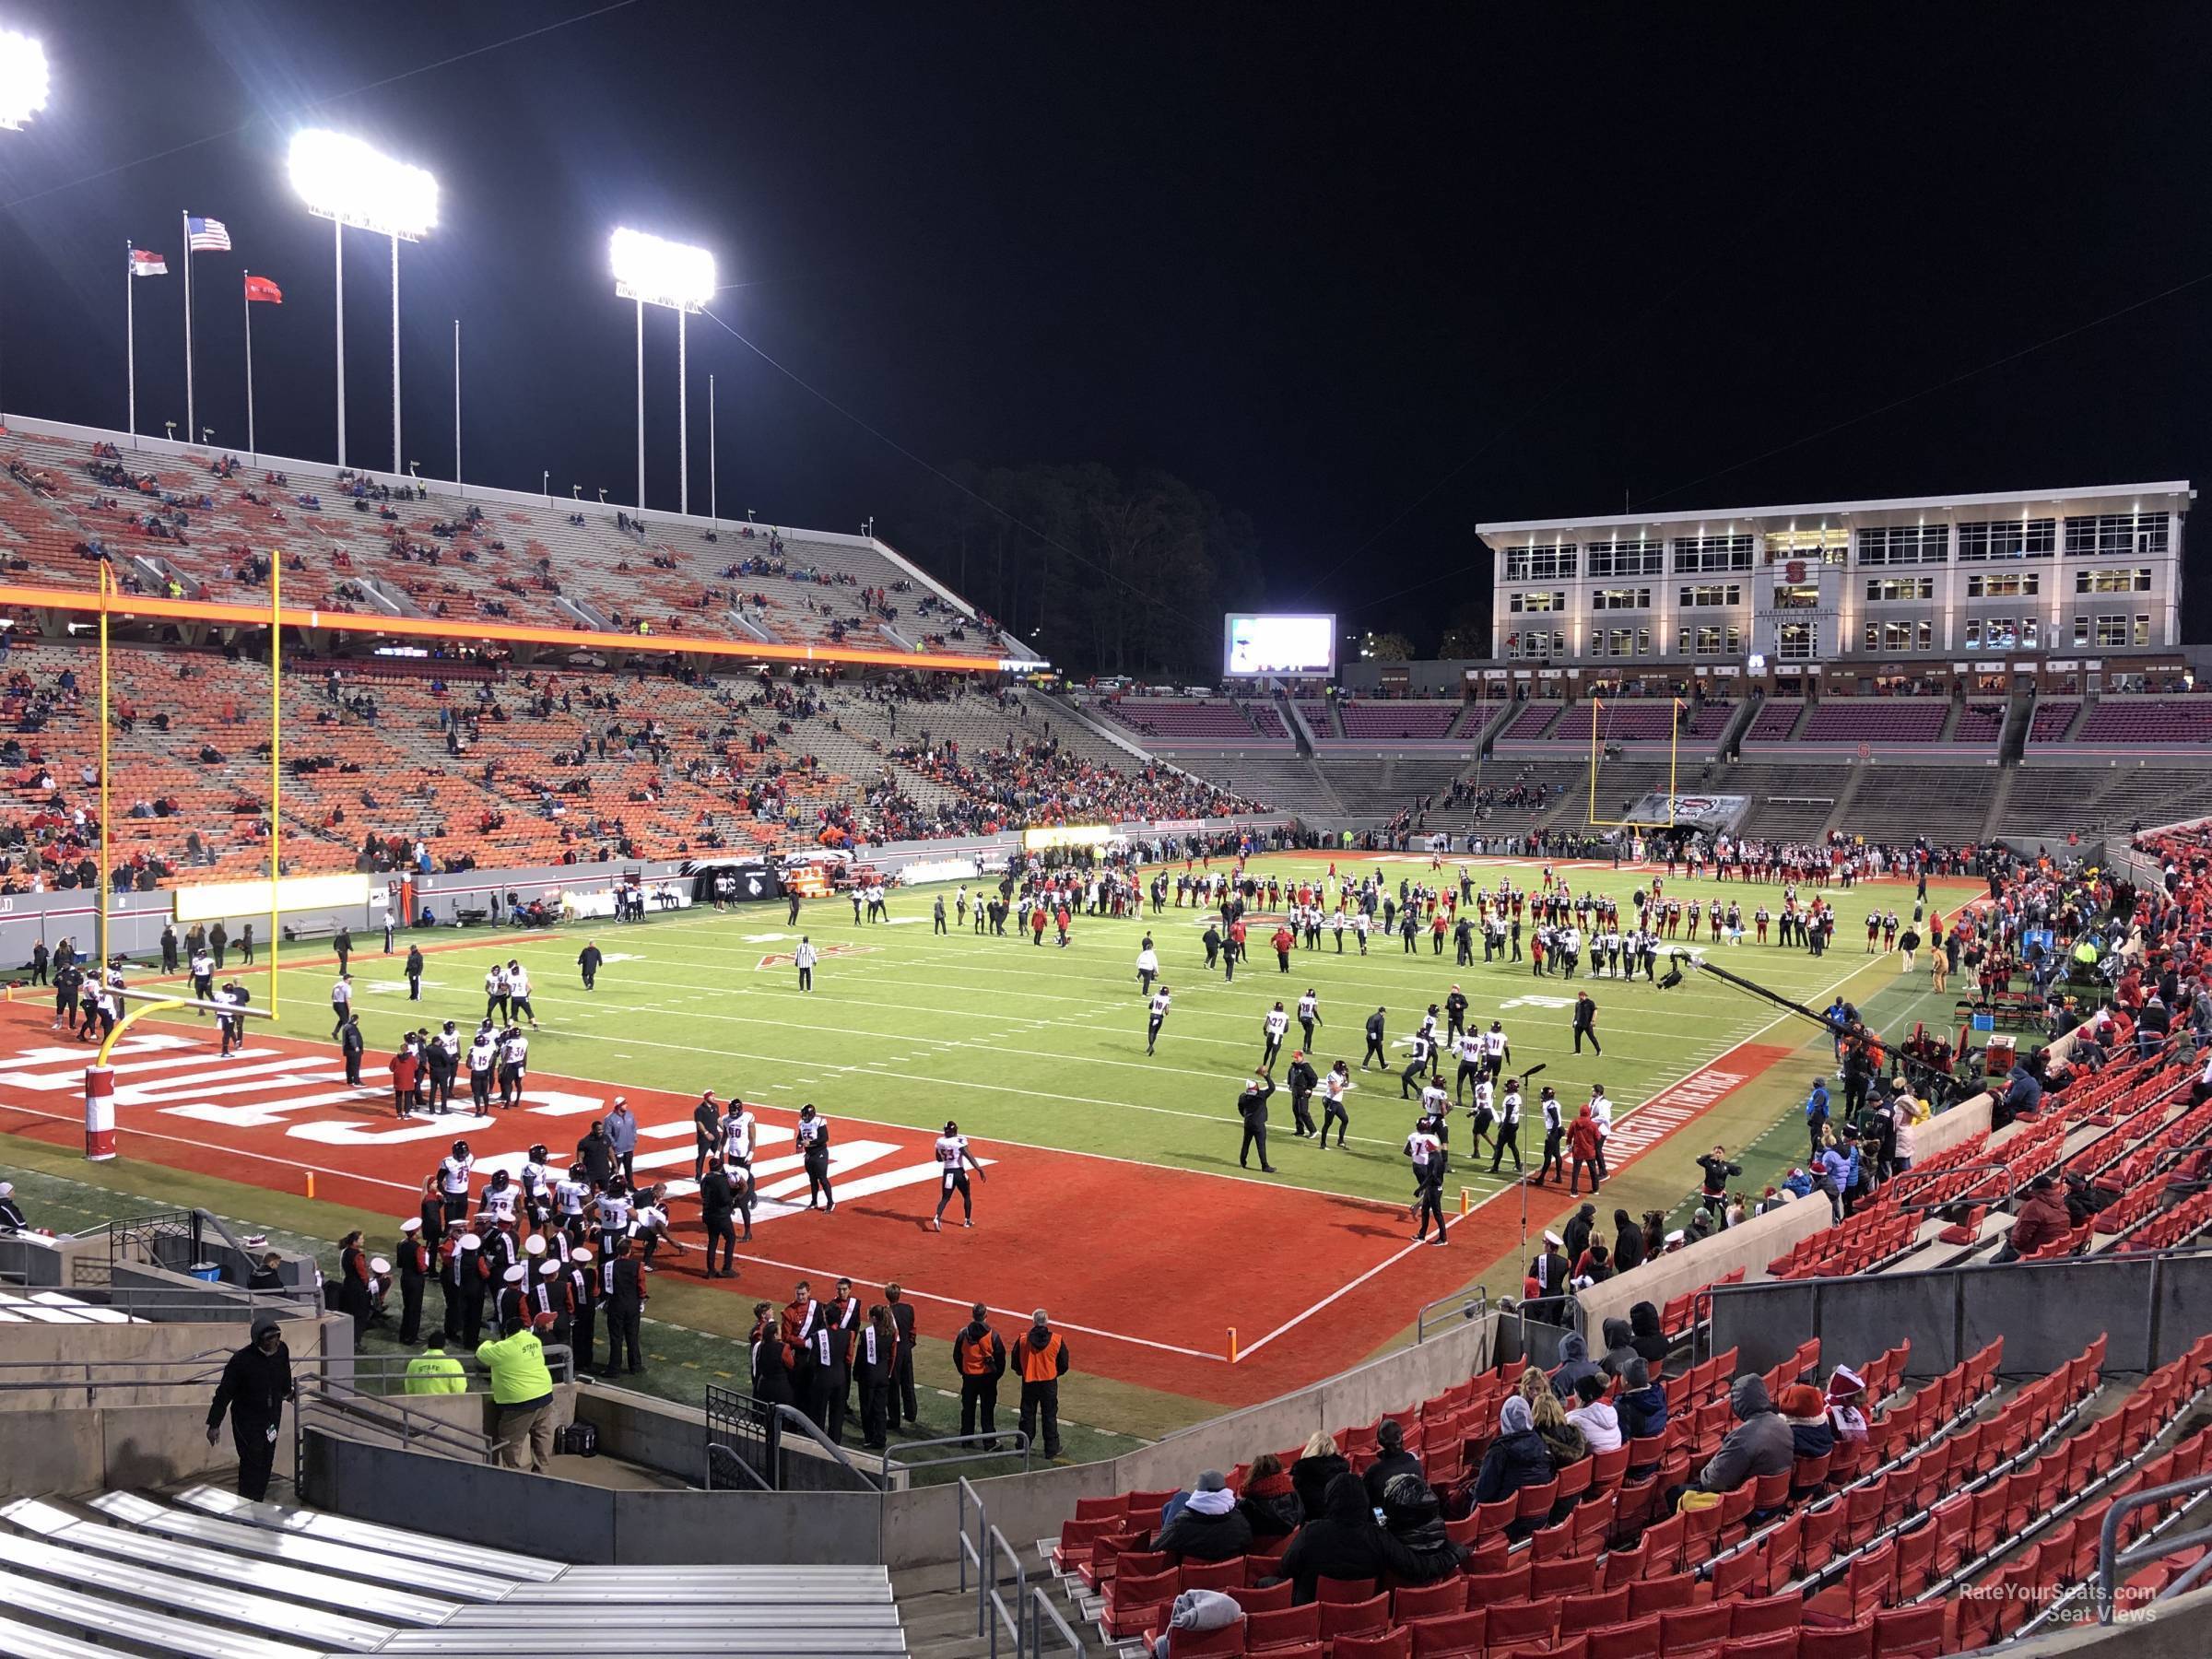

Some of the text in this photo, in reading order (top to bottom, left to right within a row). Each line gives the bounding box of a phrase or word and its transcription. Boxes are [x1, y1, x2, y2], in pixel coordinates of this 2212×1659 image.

[1466, 1042, 1478, 1053] 49
[604, 1209, 618, 1223] 91
[522, 1342, 539, 1354] STAFF
